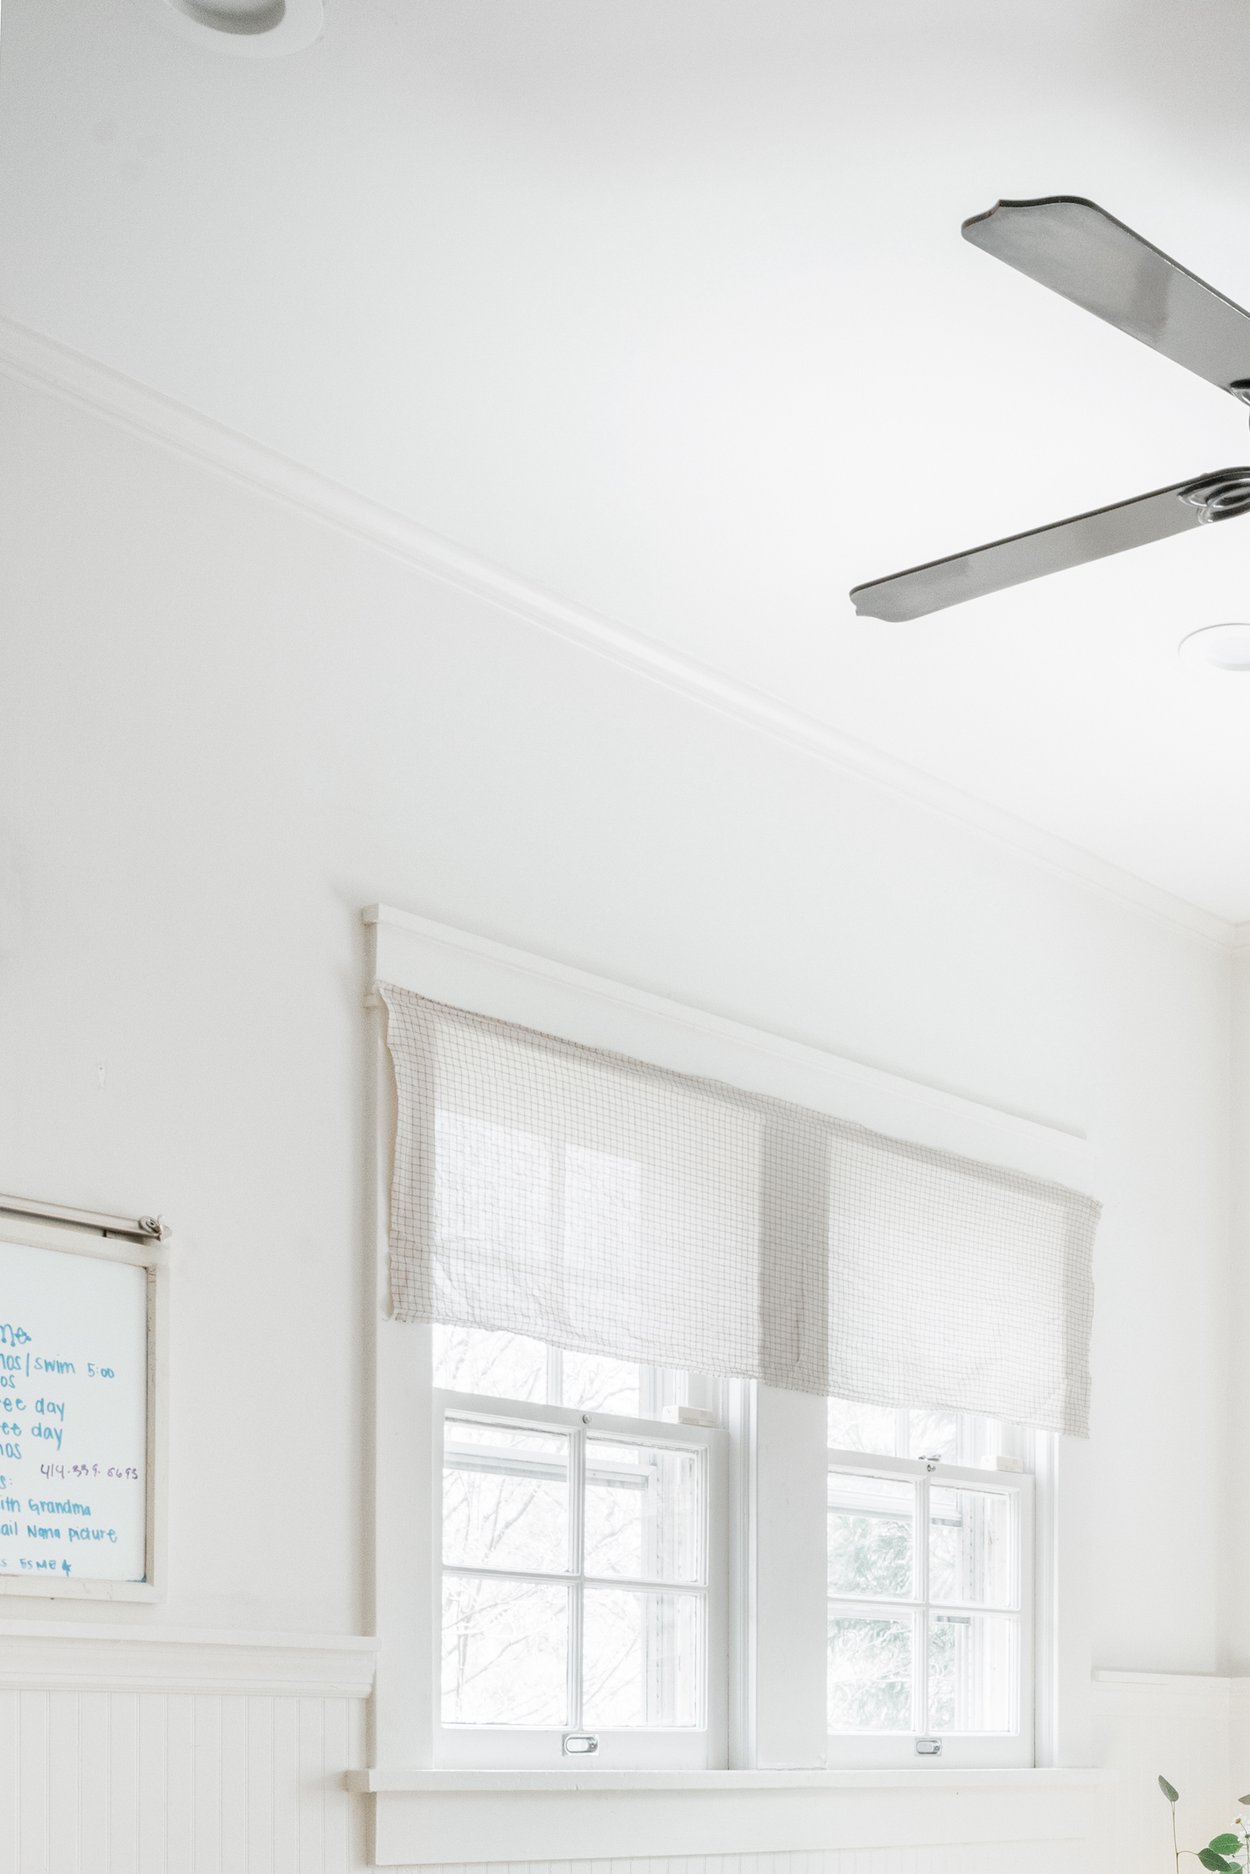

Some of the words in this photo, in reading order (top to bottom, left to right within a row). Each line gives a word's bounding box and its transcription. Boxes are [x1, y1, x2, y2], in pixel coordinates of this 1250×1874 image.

[87, 1363, 115, 1379] 5:00
[0, 1398, 26, 1412] ee
[35, 1398, 64, 1422] day
[0, 1422, 22, 1436] ee
[31, 1423, 62, 1451] day
[28, 1499, 91, 1516] Grandma
[27, 1525, 60, 1539] Nana
[68, 1527, 118, 1543] picture
